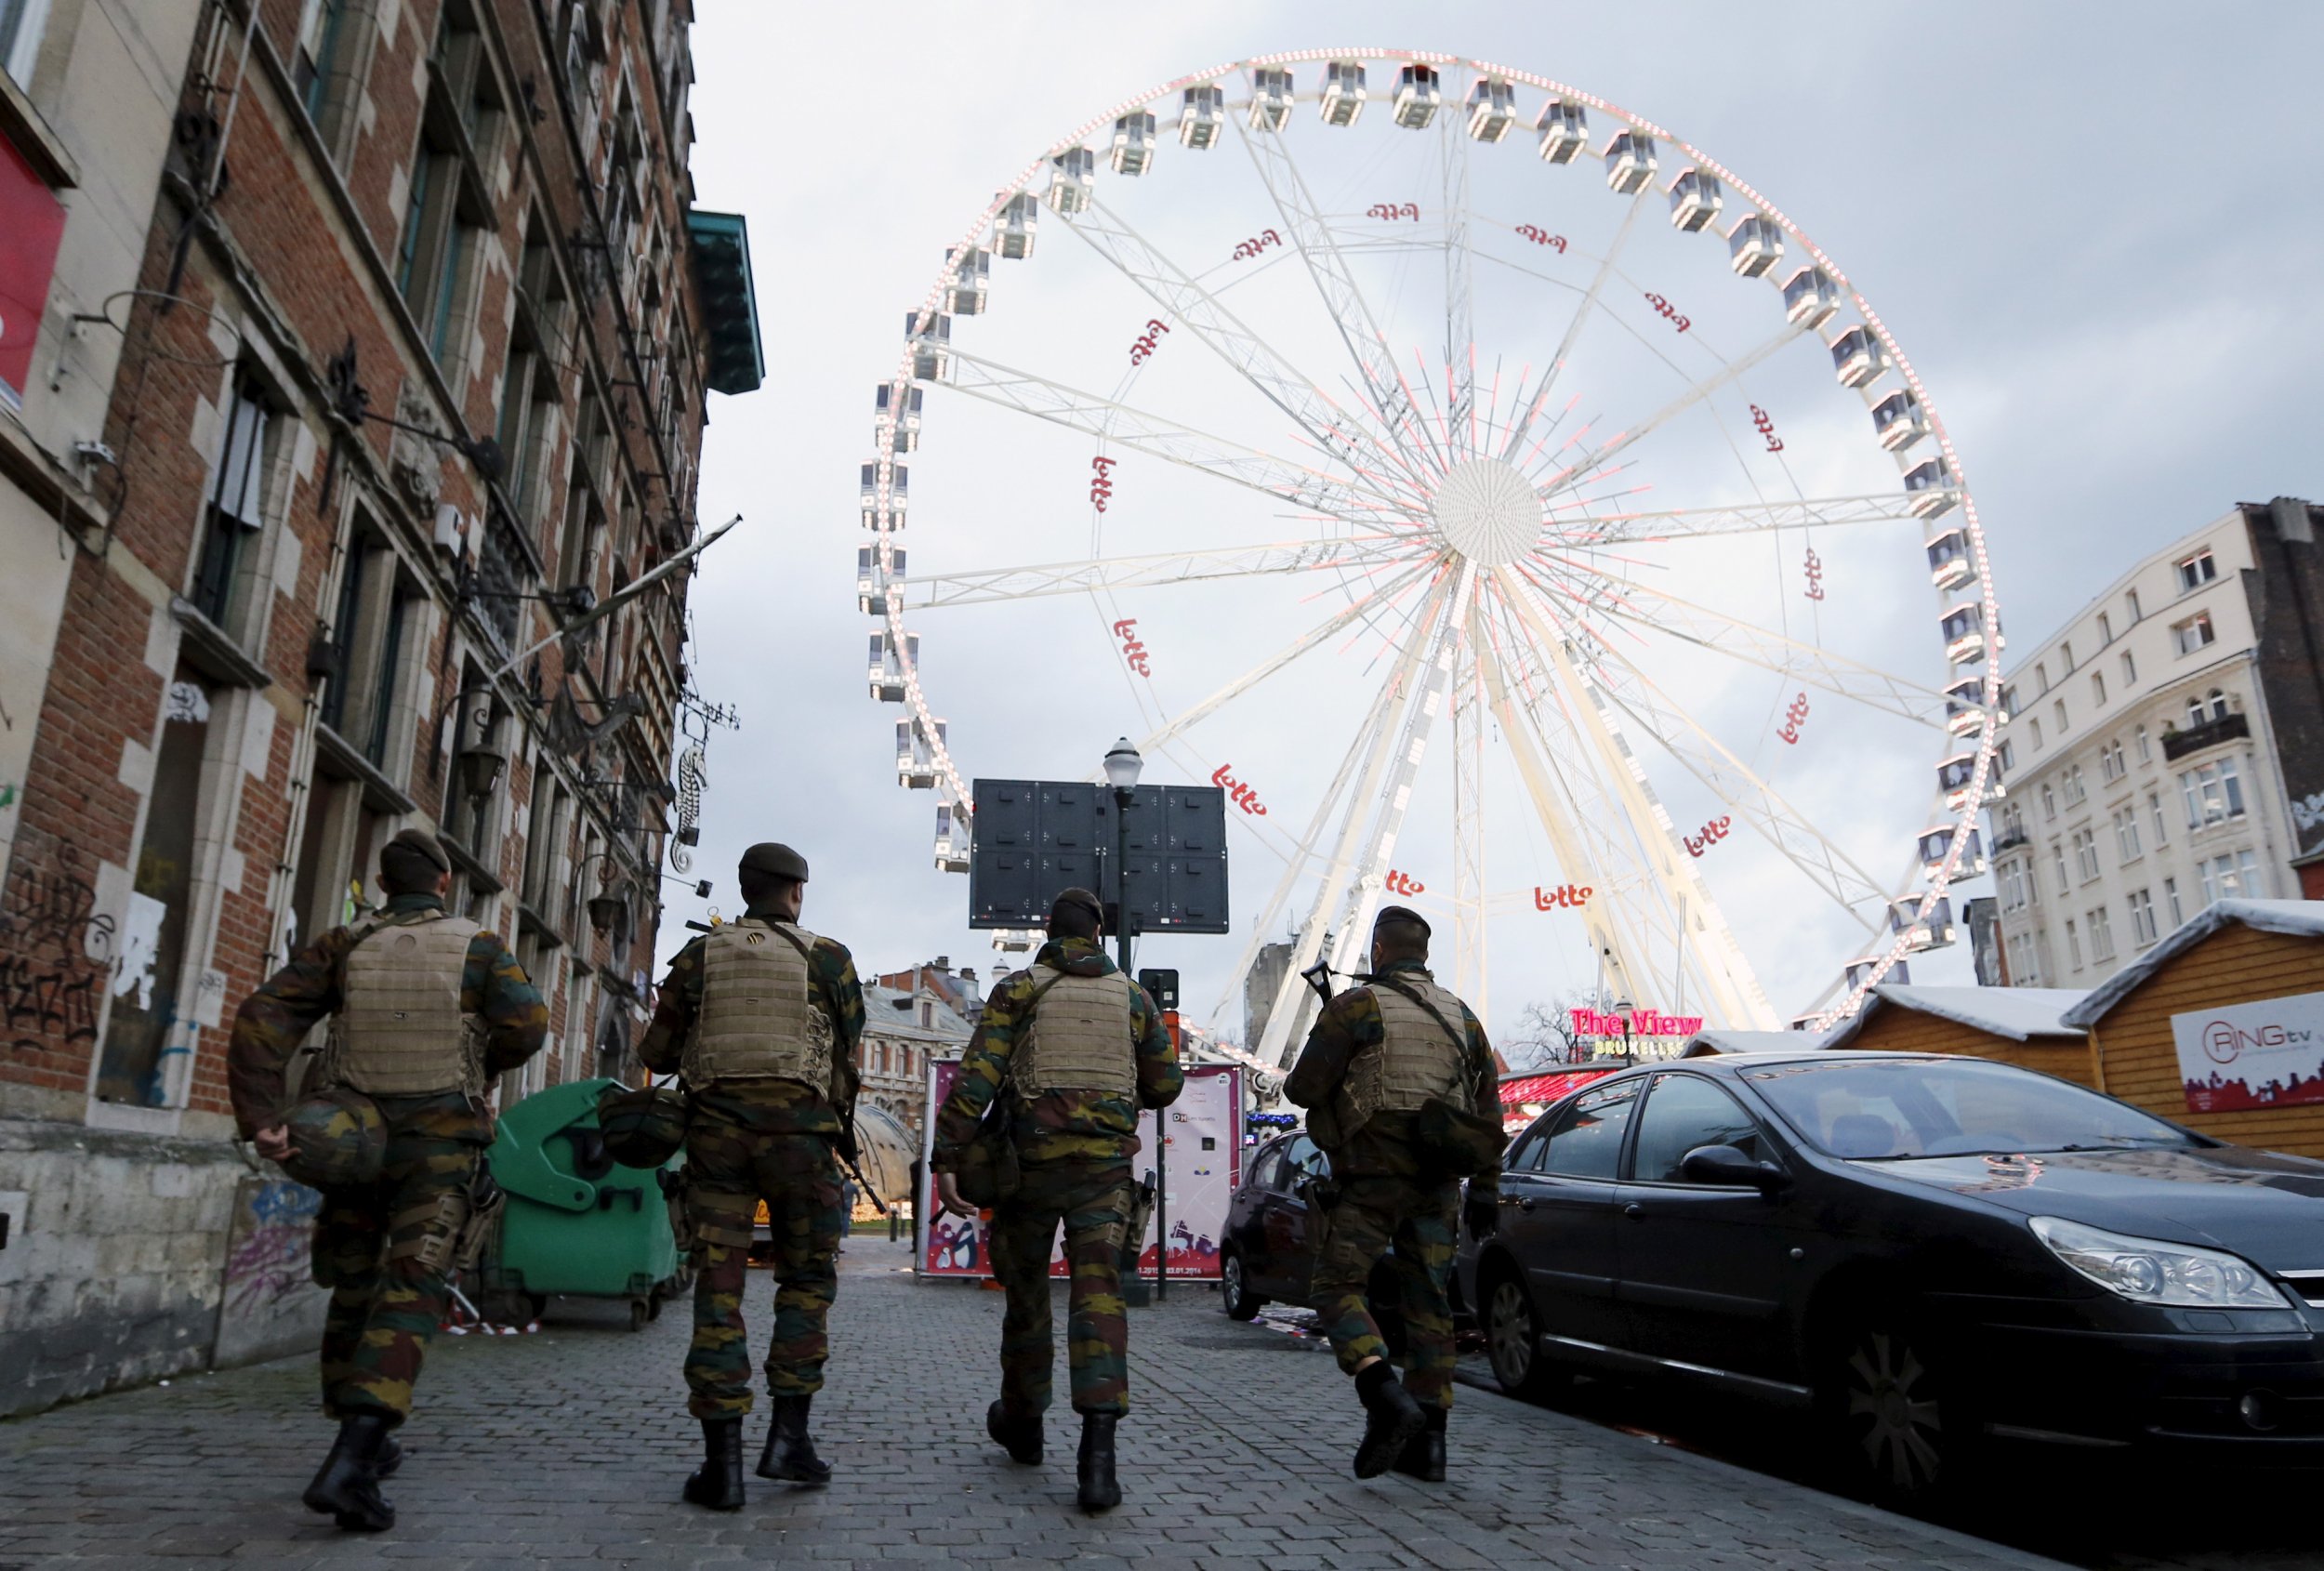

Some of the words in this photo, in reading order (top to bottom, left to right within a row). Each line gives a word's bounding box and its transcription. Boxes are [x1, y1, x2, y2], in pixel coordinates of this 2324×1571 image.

[1385, 869, 1425, 897] tto
[1569, 1008, 1624, 1036] The
[1631, 1009, 1705, 1036] View
